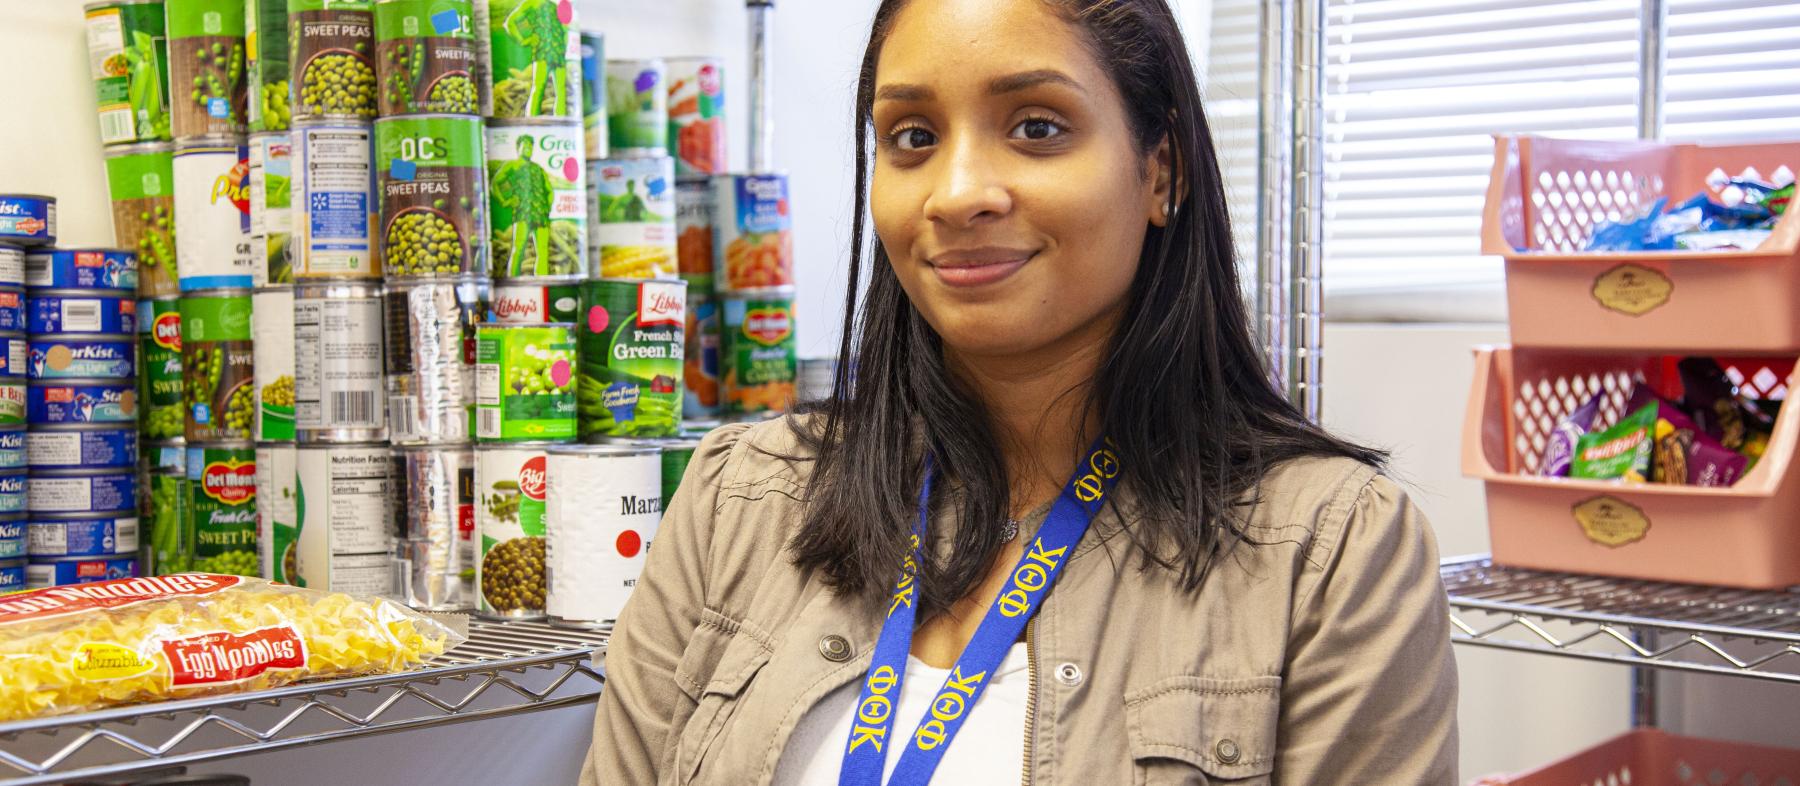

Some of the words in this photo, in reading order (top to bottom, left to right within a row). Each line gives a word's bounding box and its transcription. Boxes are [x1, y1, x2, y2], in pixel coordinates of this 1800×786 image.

[304, 25, 339, 37] SWEET
[342, 25, 370, 37] PEAS
[435, 49, 463, 59] SWEET
[387, 183, 418, 196] SWEET
[421, 182, 450, 194] PEAS
[496, 295, 537, 317] Libby's
[634, 330, 672, 342] French
[72, 345, 113, 359] rKist
[614, 344, 667, 360] Green
[103, 389, 122, 402] Sta
[0, 434, 22, 448] Kist
[332, 456, 366, 464] Nutrition
[368, 455, 387, 464] Facts
[0, 479, 22, 492] Kist
[207, 474, 225, 487] Del
[519, 468, 545, 494] Big
[221, 488, 247, 498] Quality
[332, 486, 359, 494] Calories
[209, 510, 237, 524] Fresh
[198, 530, 241, 545] SWEET
[47, 574, 220, 602] Noodles
[623, 579, 636, 588] NET
[176, 644, 217, 679] Egg
[212, 638, 296, 671] Noodles
